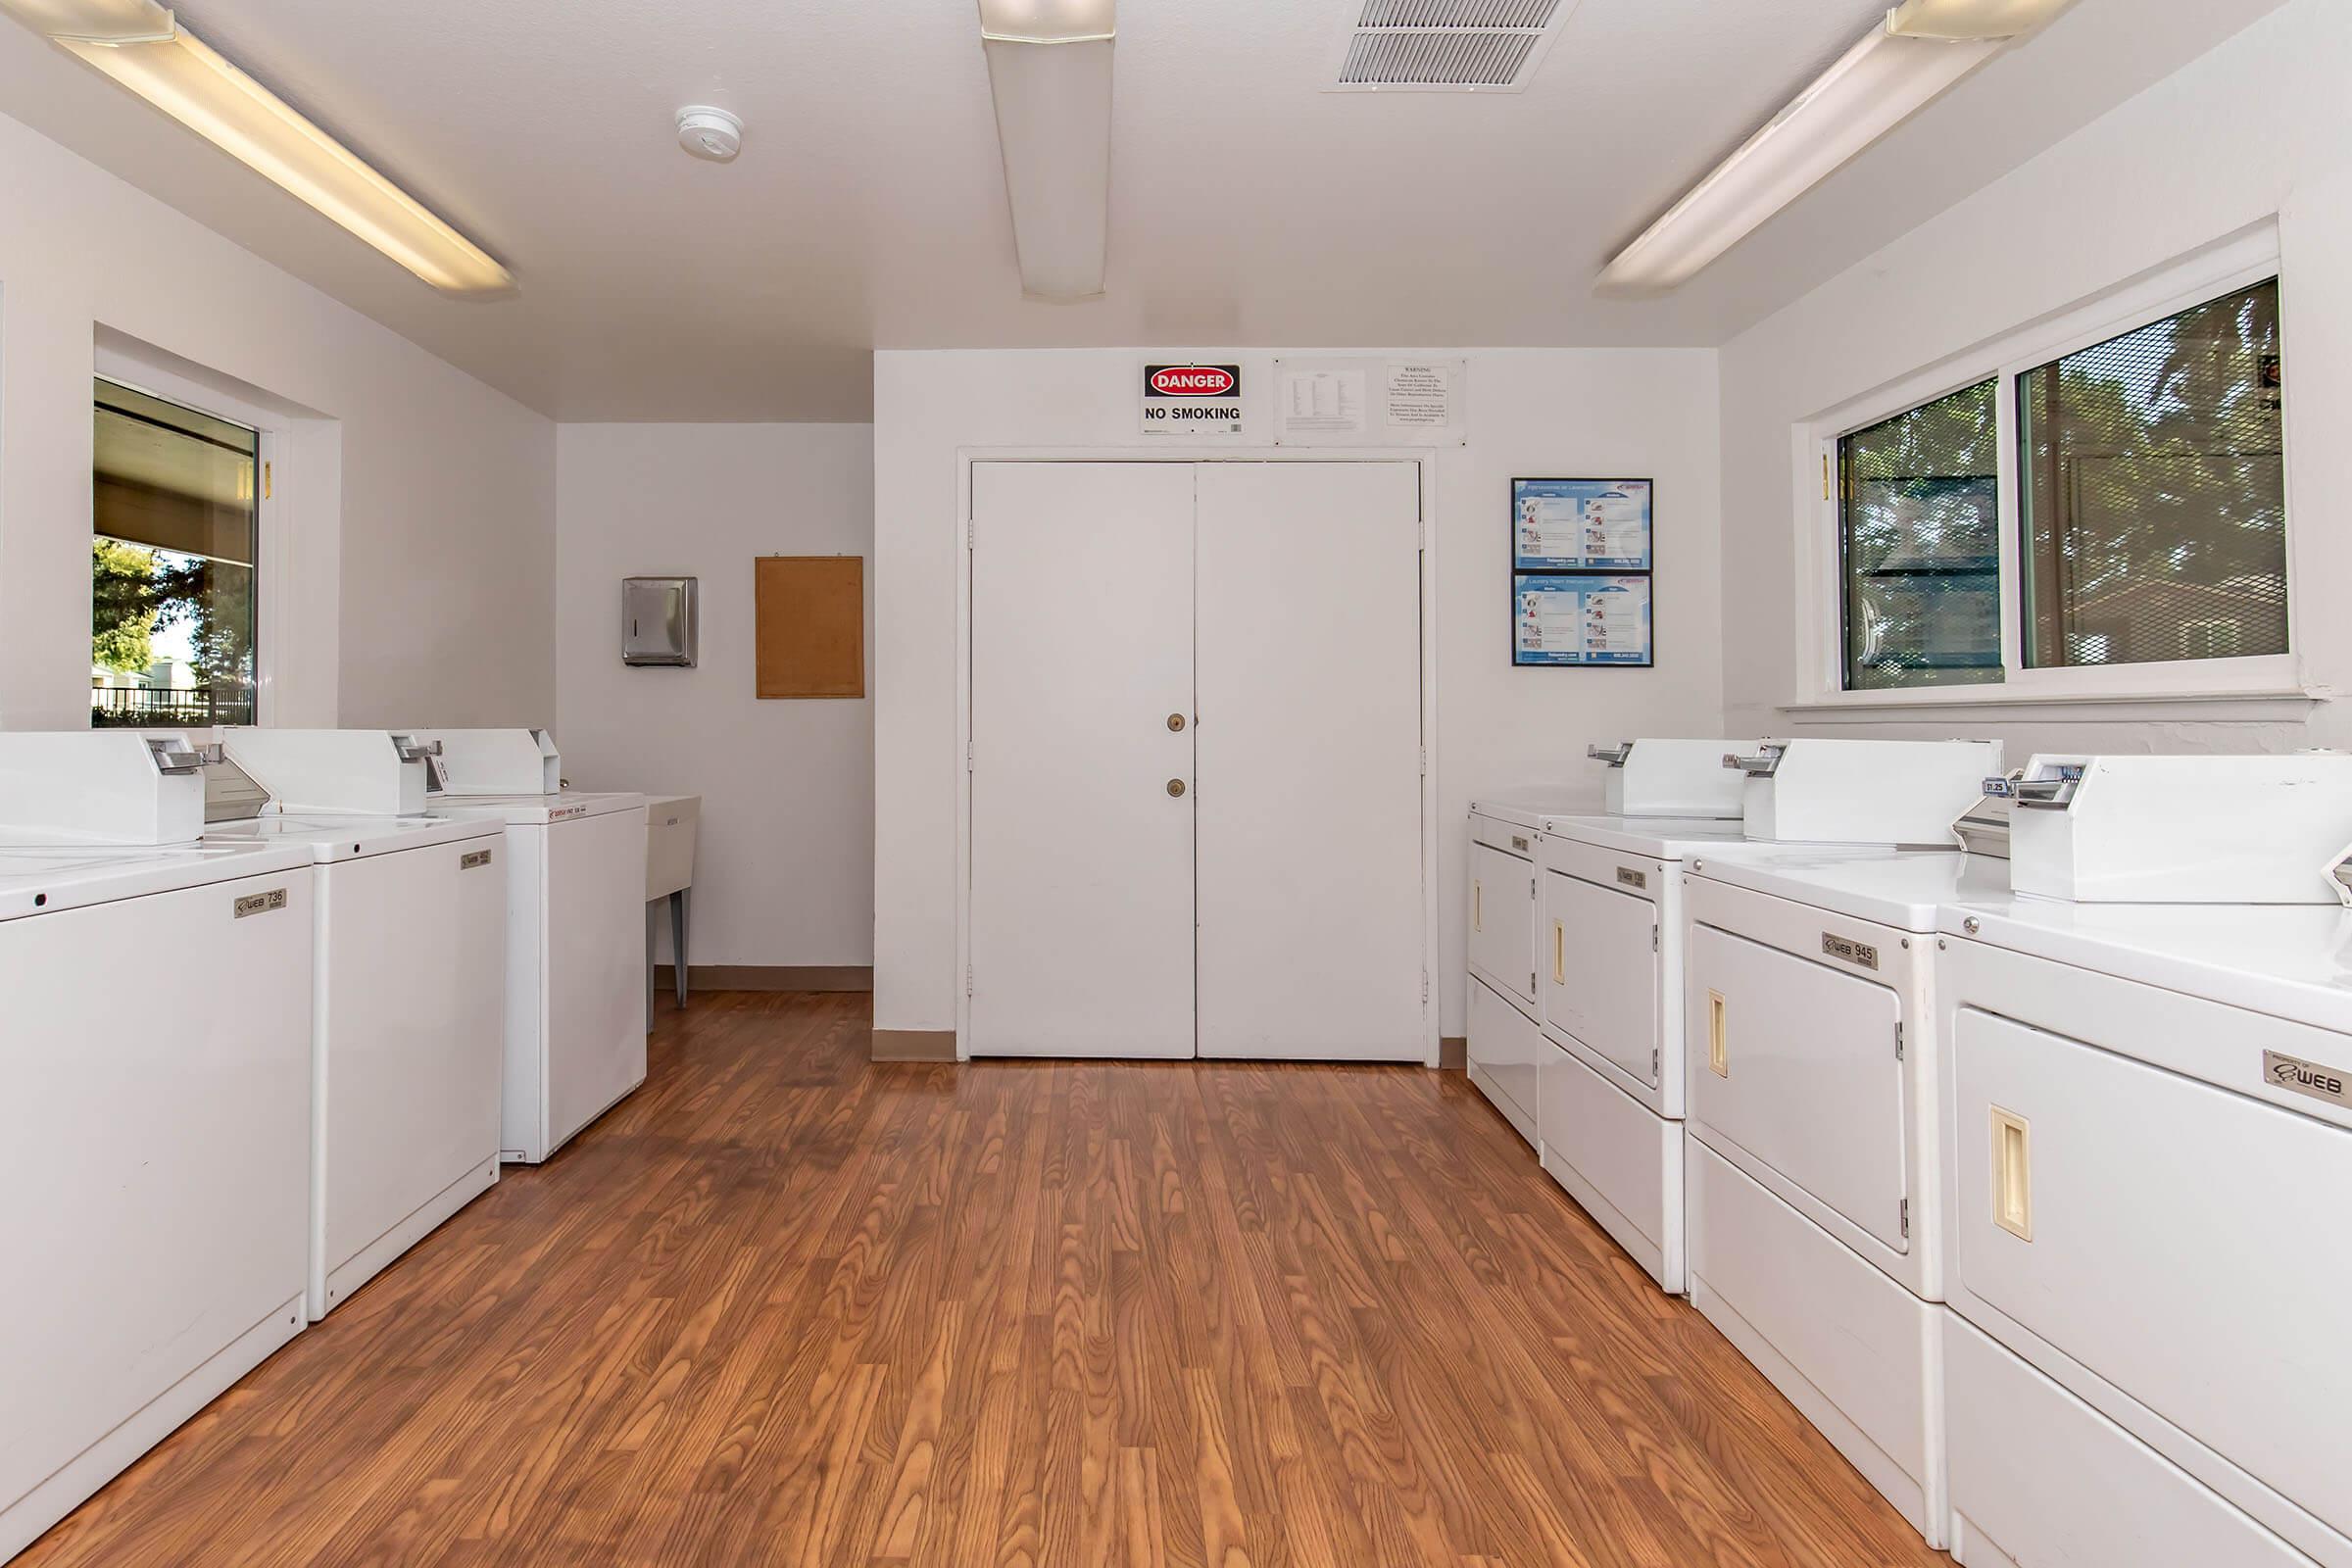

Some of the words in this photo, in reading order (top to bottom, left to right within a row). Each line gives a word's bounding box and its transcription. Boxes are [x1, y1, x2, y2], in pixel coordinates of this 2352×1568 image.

[1157, 374, 1226, 388] DANGER
[1145, 408, 1166, 419] NO
[1171, 408, 1240, 419] SMOKING
[268, 891, 282, 902] 736
[1835, 943, 1851, 955] WEB
[1855, 945, 1873, 959] 945
[2297, 1069, 2341, 1094] WEB
